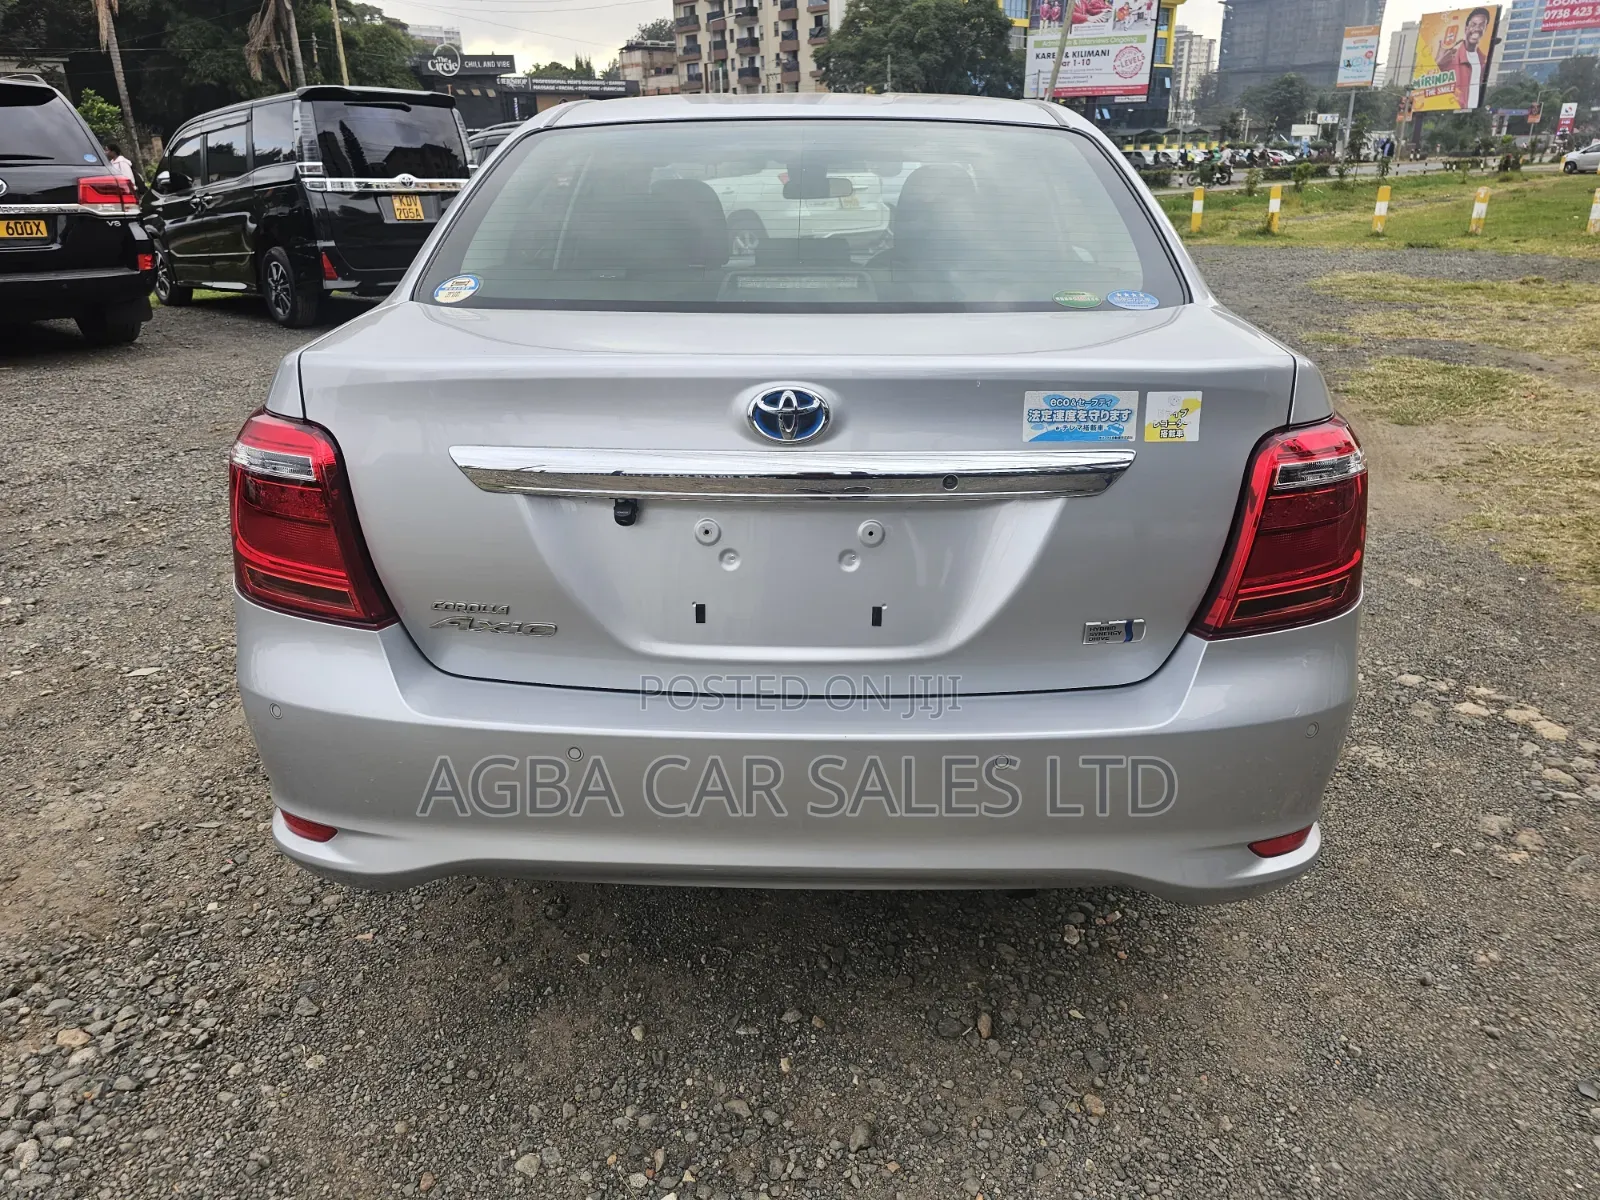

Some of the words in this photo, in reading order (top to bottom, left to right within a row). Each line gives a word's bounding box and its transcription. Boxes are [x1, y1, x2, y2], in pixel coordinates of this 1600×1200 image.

[1572, 6, 1594, 17] 423
[1035, 51, 1056, 60] KARE
[1064, 51, 1070, 59] &
[1072, 49, 1110, 58] KILIMANI
[427, 59, 458, 72] Circle
[464, 60, 481, 69] CHILL
[483, 60, 496, 68] AND
[497, 60, 511, 68] VIBE
[1073, 58, 1091, 67] 1-10
[398, 195, 418, 207] KDV
[396, 208, 422, 219] 705A
[5, 221, 44, 236] 600X
[1027, 408, 1132, 423] 法定速度を守ります
[431, 600, 510, 616] COROLLA
